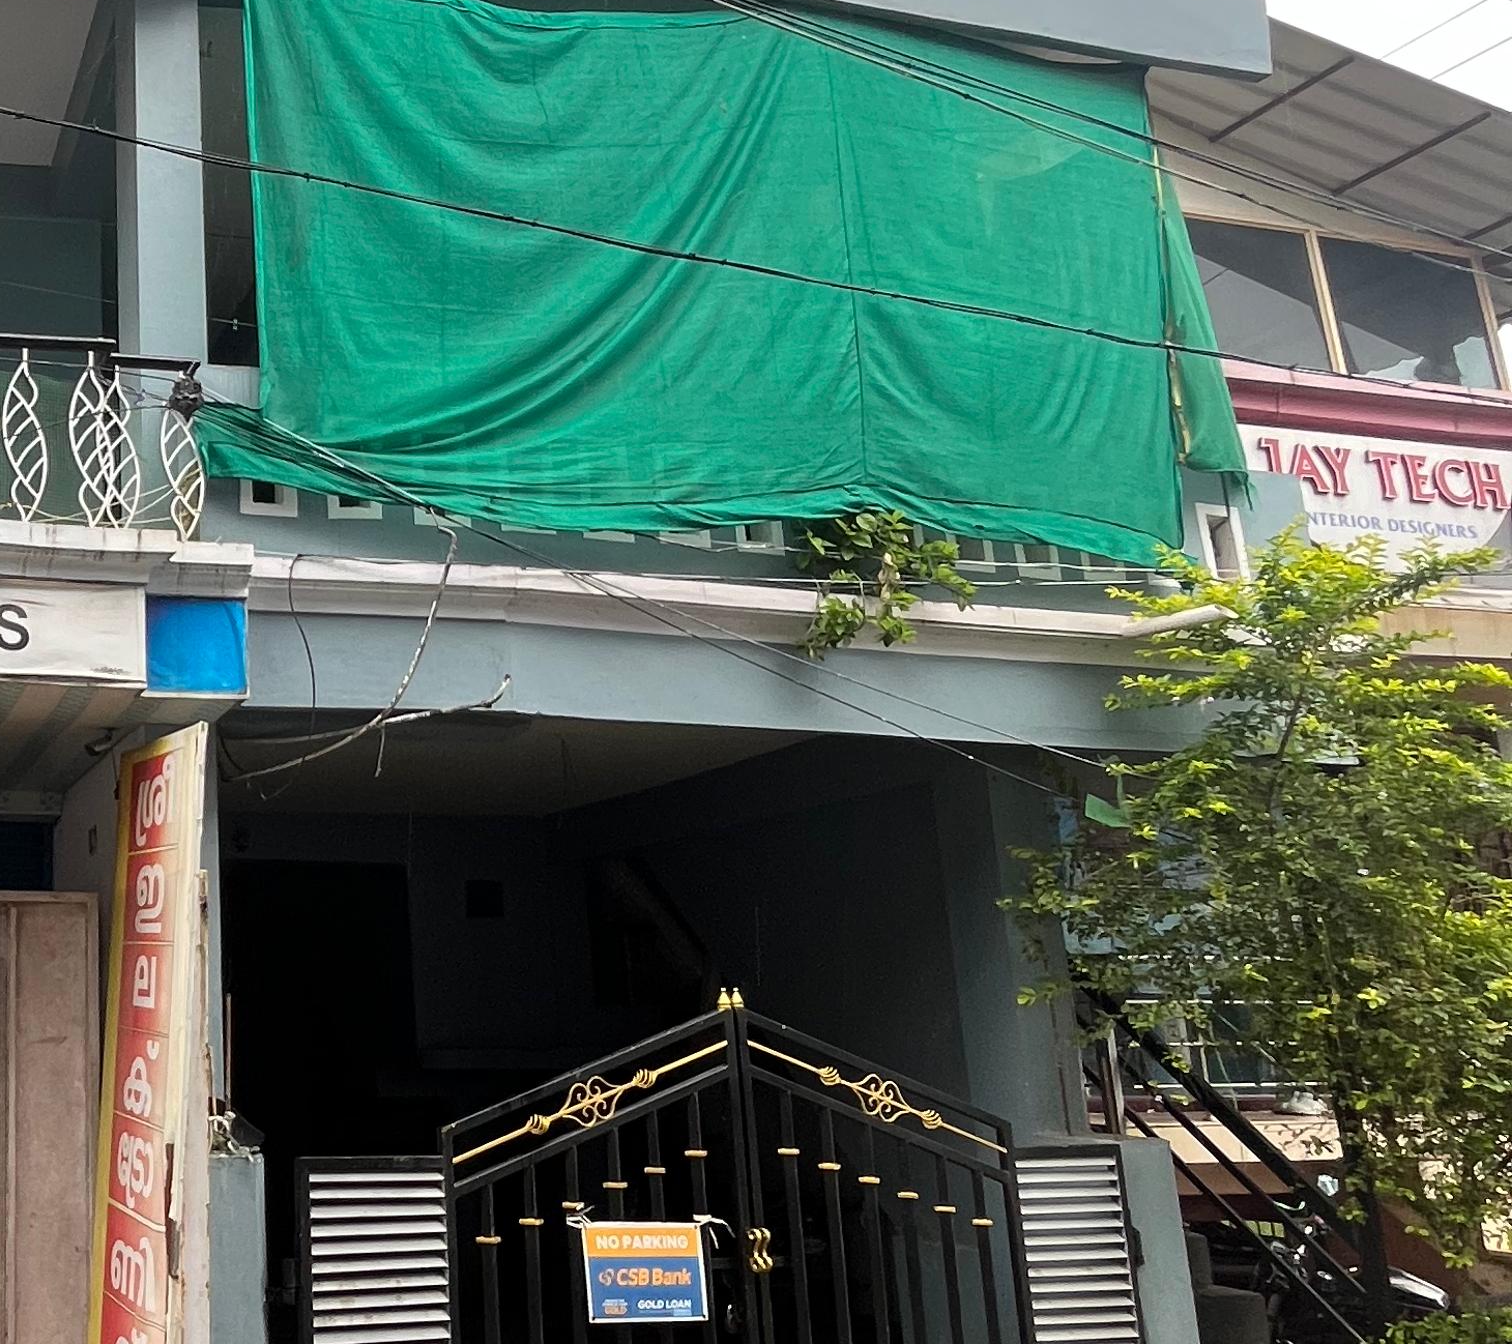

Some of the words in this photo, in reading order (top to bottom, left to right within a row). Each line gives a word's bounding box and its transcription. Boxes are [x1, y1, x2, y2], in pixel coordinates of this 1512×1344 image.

[1365, 449, 1511, 511] TECH
[1388, 518, 1479, 539] DESIGNERS
[595, 1234, 620, 1249] NO
[622, 1234, 688, 1249] PARKING
[616, 1267, 649, 1285] CSB
[652, 1267, 692, 1285] Bank
[637, 1299, 664, 1309] GOLD
[666, 1299, 692, 1309] LOAN
